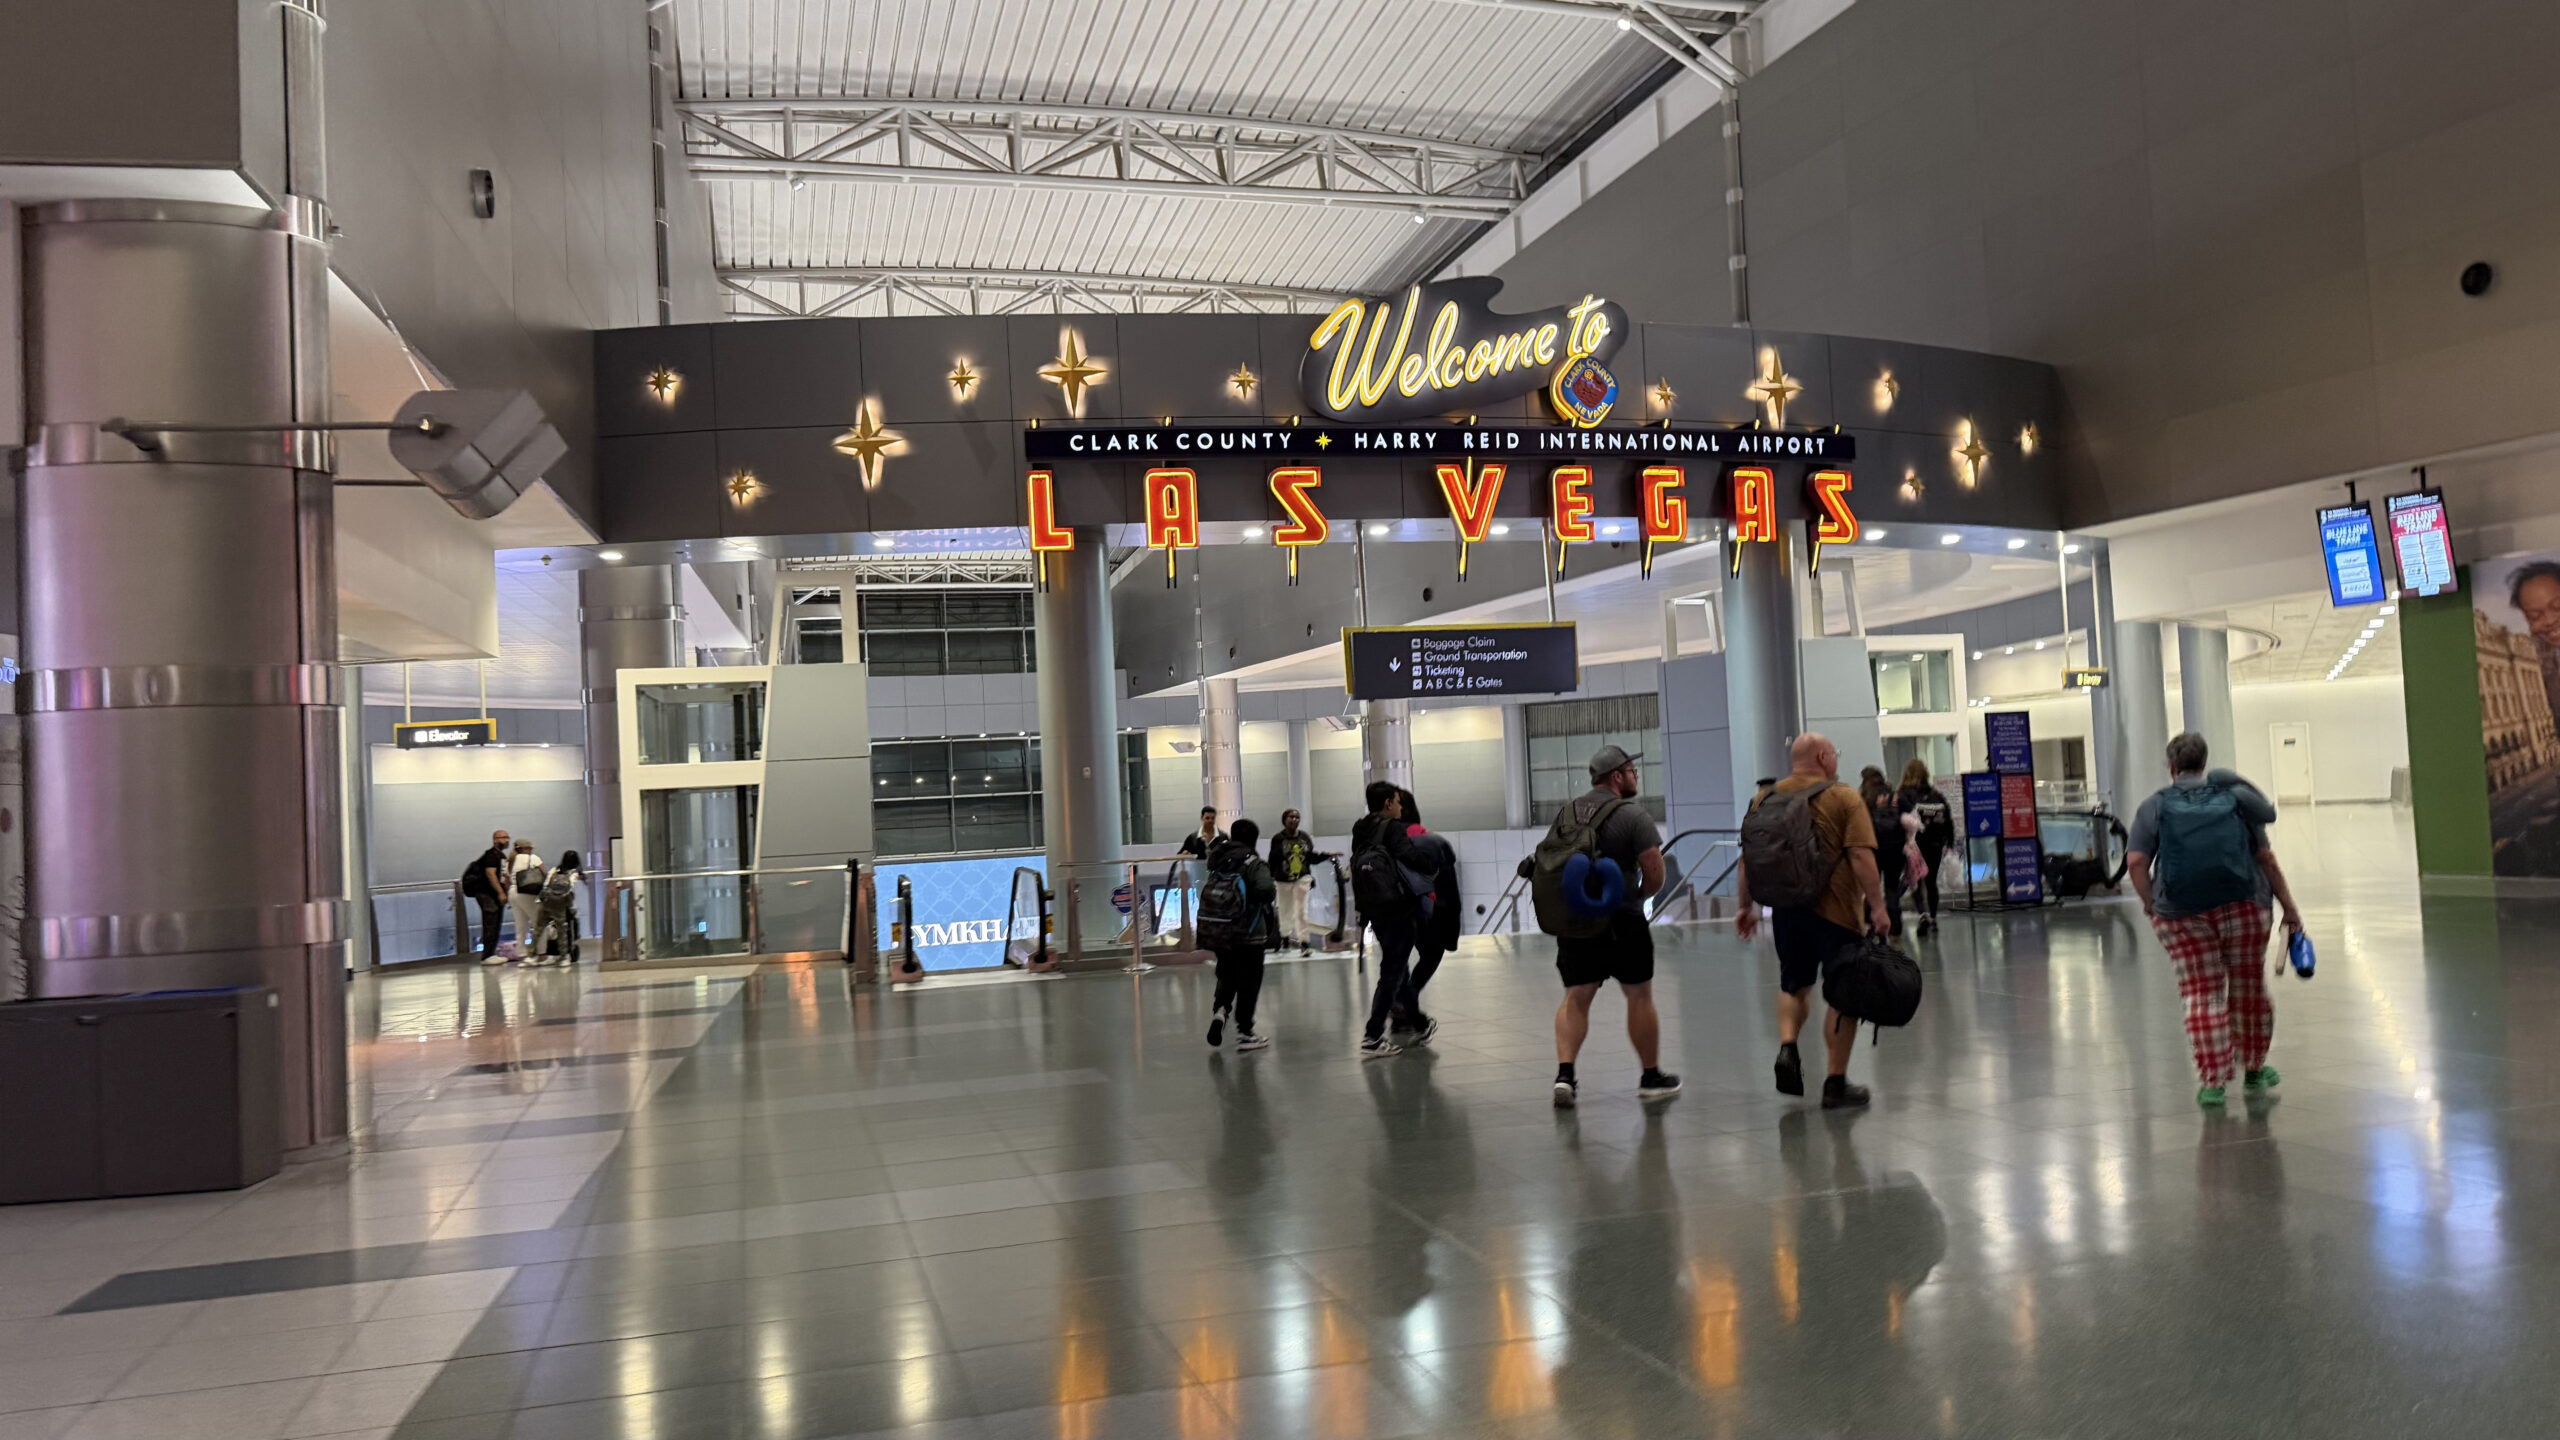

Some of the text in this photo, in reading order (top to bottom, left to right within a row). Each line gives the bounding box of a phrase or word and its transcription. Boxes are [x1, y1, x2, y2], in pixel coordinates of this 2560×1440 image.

[1310, 283, 1610, 411] Welcome to
[1564, 358, 1616, 389] CLARK COUNTY
[1574, 401, 1609, 419] NEVADA
[1069, 431, 1826, 455] CLARK COUNTY HARRY REID INTERNATIONAL AIRPORT
[1026, 464, 1860, 552] LAS VEGAS
[1423, 636, 1496, 651] Baggage Claim
[1424, 648, 1528, 663] Ground Transportation
[1425, 664, 1465, 677] Ticketing
[1424, 675, 1503, 691] A B C & E Gates
[428, 728, 470, 742] Elevator
